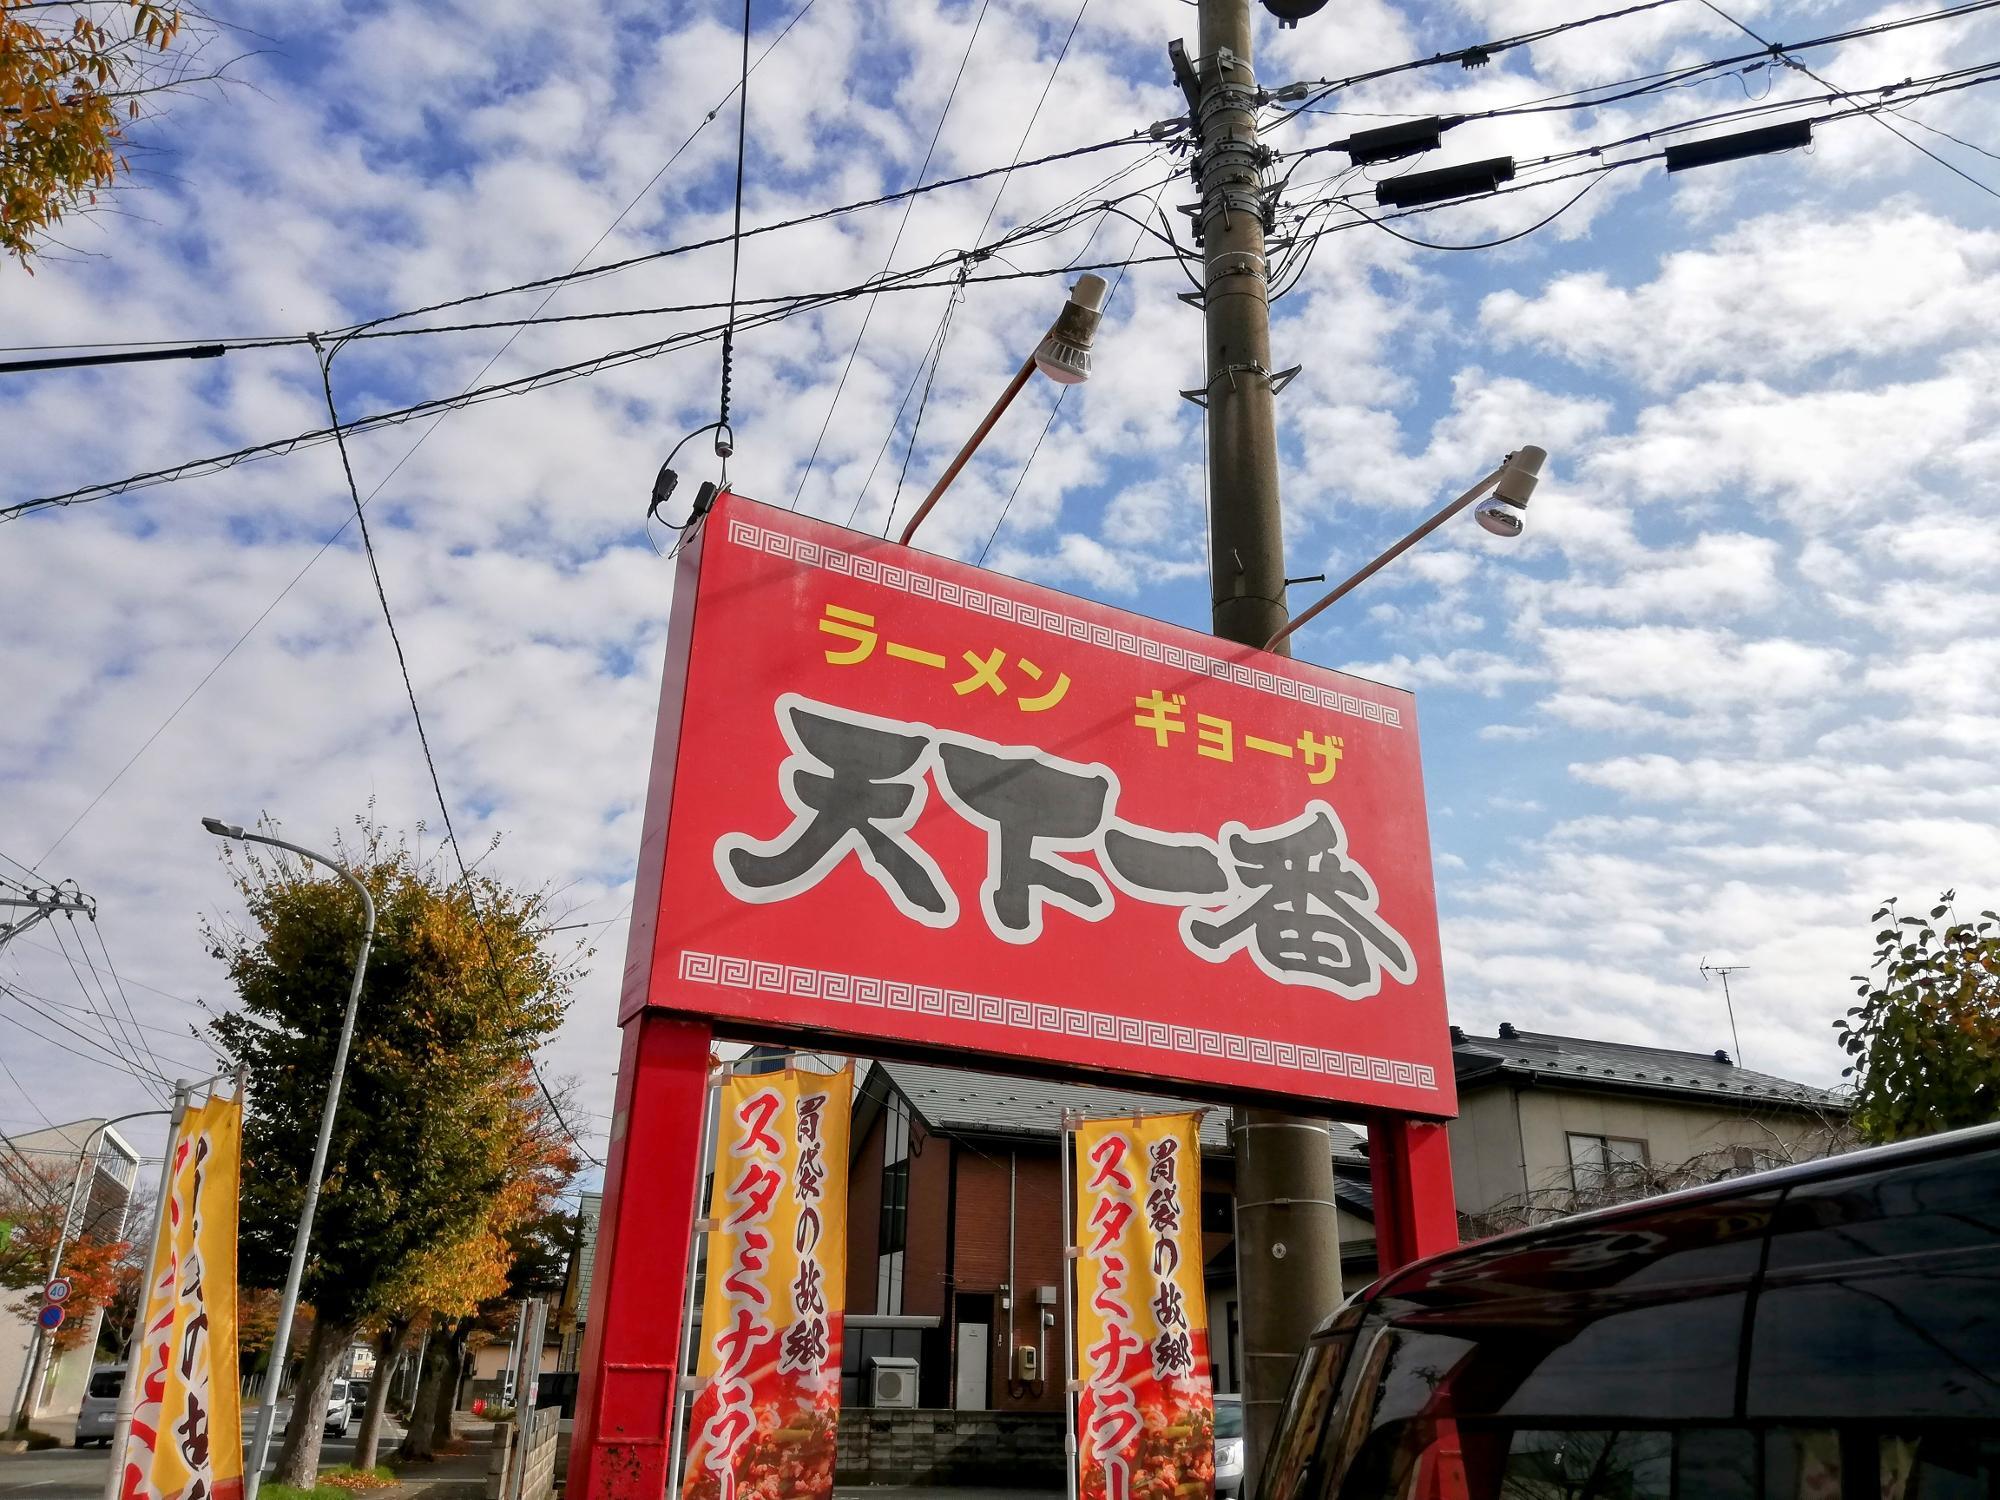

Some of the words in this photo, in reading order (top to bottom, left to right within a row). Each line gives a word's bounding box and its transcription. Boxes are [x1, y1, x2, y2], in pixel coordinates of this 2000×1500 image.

[818, 604, 1071, 712] ラーメン
[1134, 689, 1344, 785] ギョーザ
[713, 692, 1417, 1000] 天下一番
[50, 1286, 65, 1297] 40
